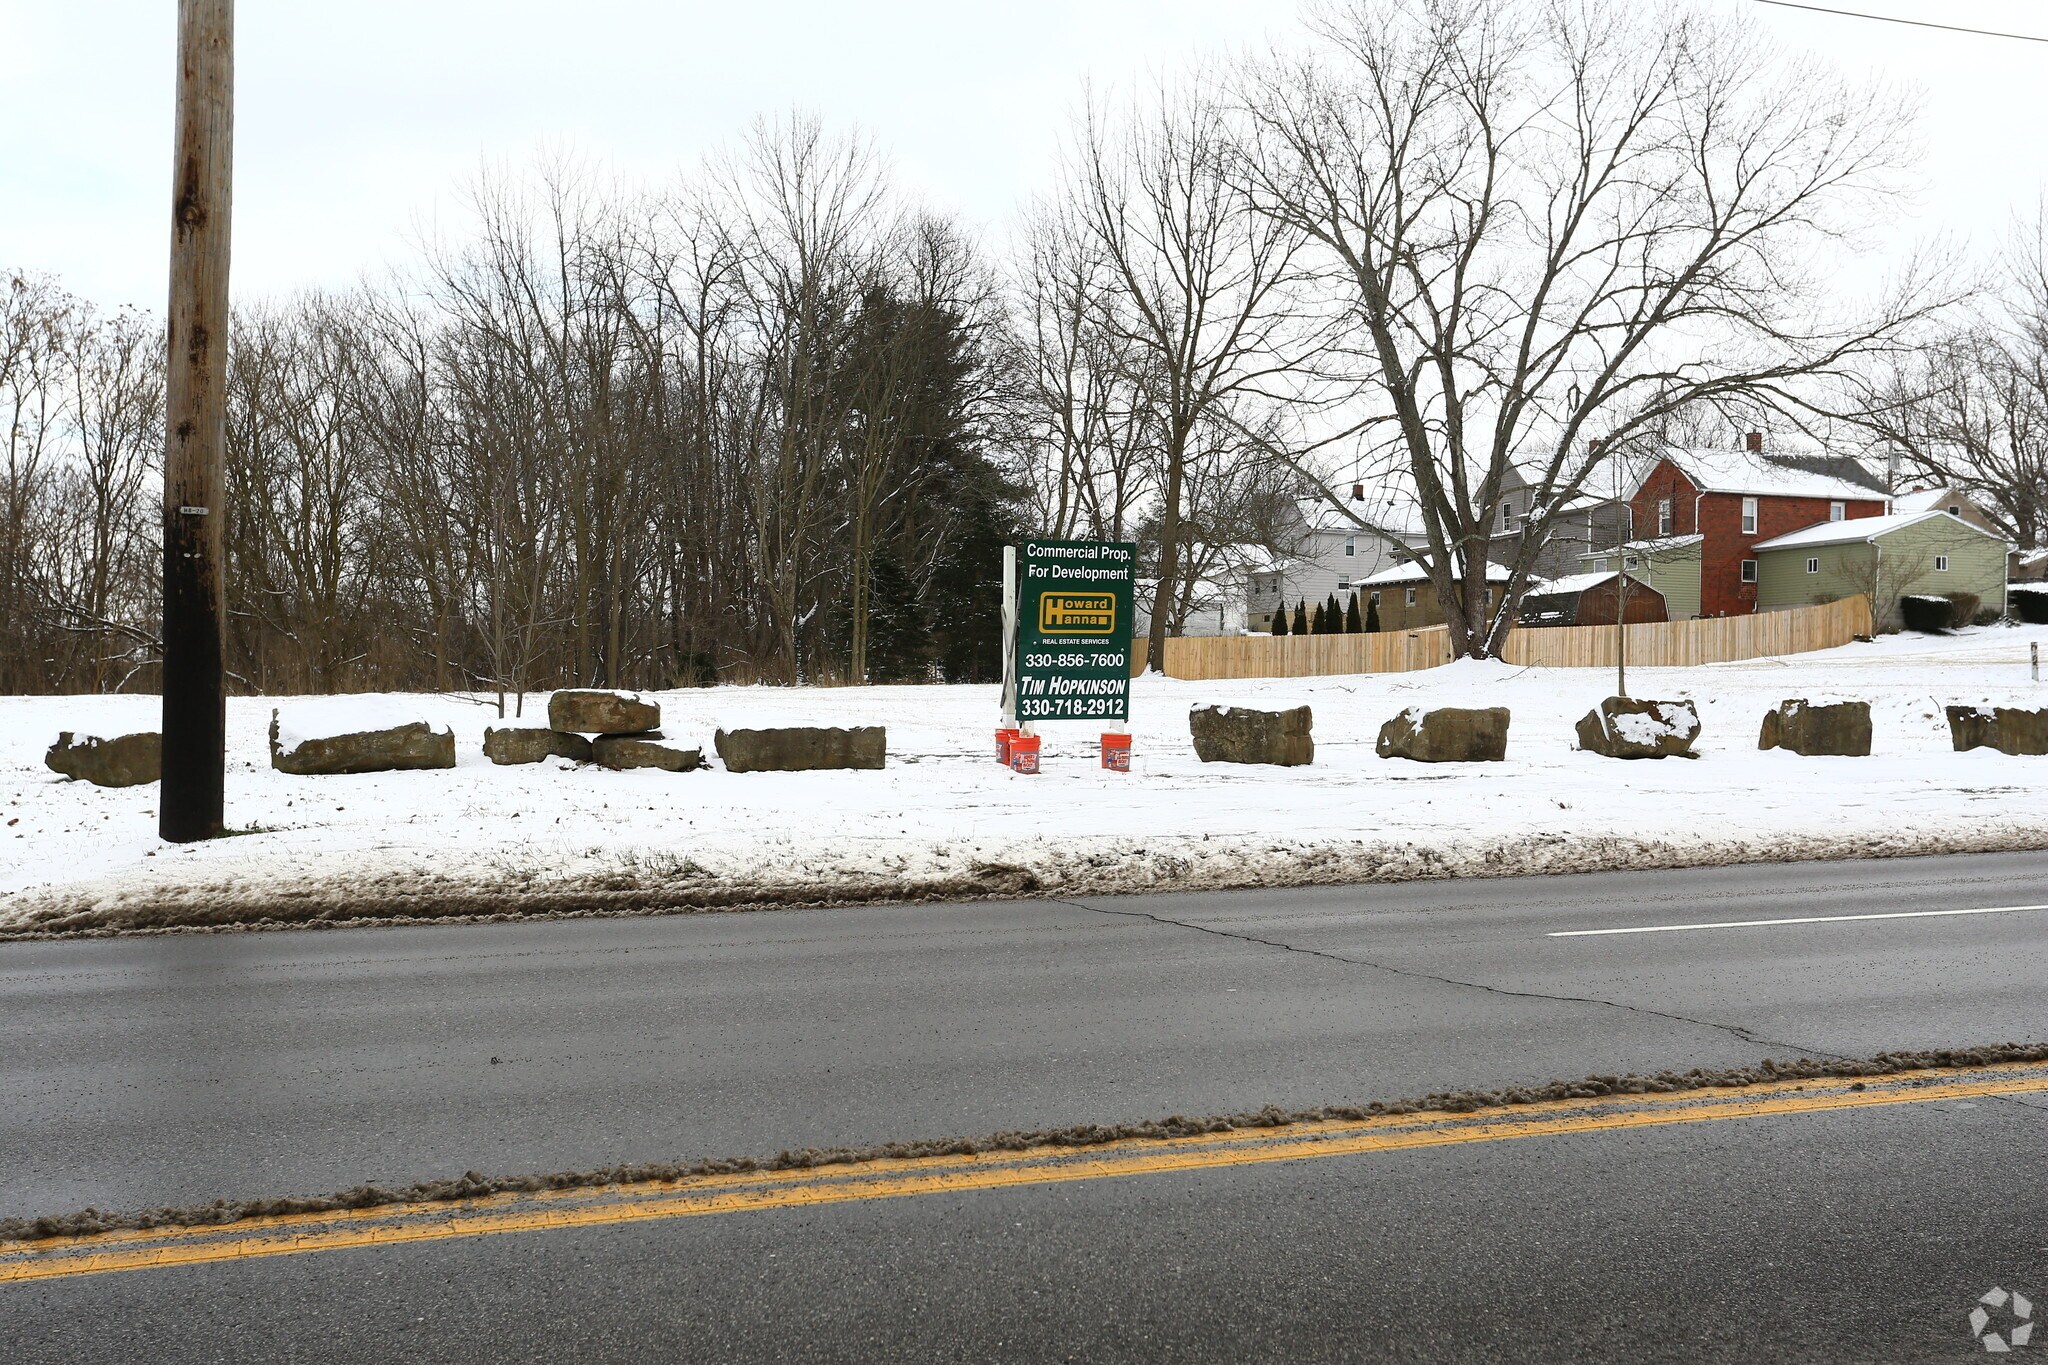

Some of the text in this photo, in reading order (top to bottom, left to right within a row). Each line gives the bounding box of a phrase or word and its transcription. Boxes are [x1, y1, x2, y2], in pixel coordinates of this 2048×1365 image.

[1027, 543, 1131, 562] Commercial Prop.
[1028, 564, 1129, 581] For Development
[1045, 599, 1107, 613] Howard
[1045, 612, 1099, 625] Hanna
[1025, 654, 1124, 667] 330-856-7600
[1021, 676, 1126, 695] TIM HOPKINSON
[1021, 699, 1124, 715] 330-718-2912
